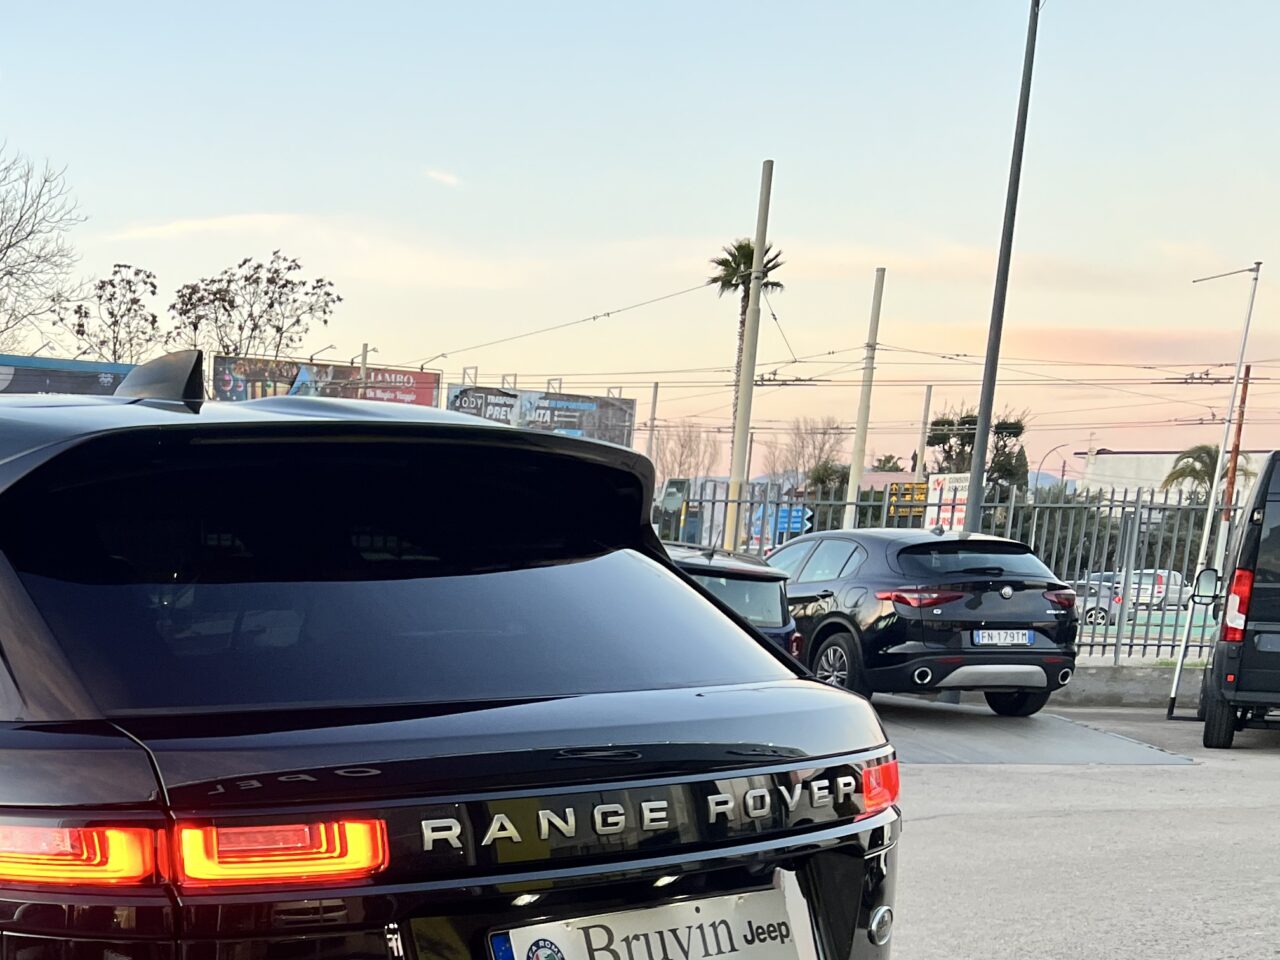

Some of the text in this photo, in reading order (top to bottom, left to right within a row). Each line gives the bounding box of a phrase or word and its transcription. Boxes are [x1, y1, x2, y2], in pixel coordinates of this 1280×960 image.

[421, 775, 856, 851] RANGE ROVER
[743, 920, 790, 945] Jeep
